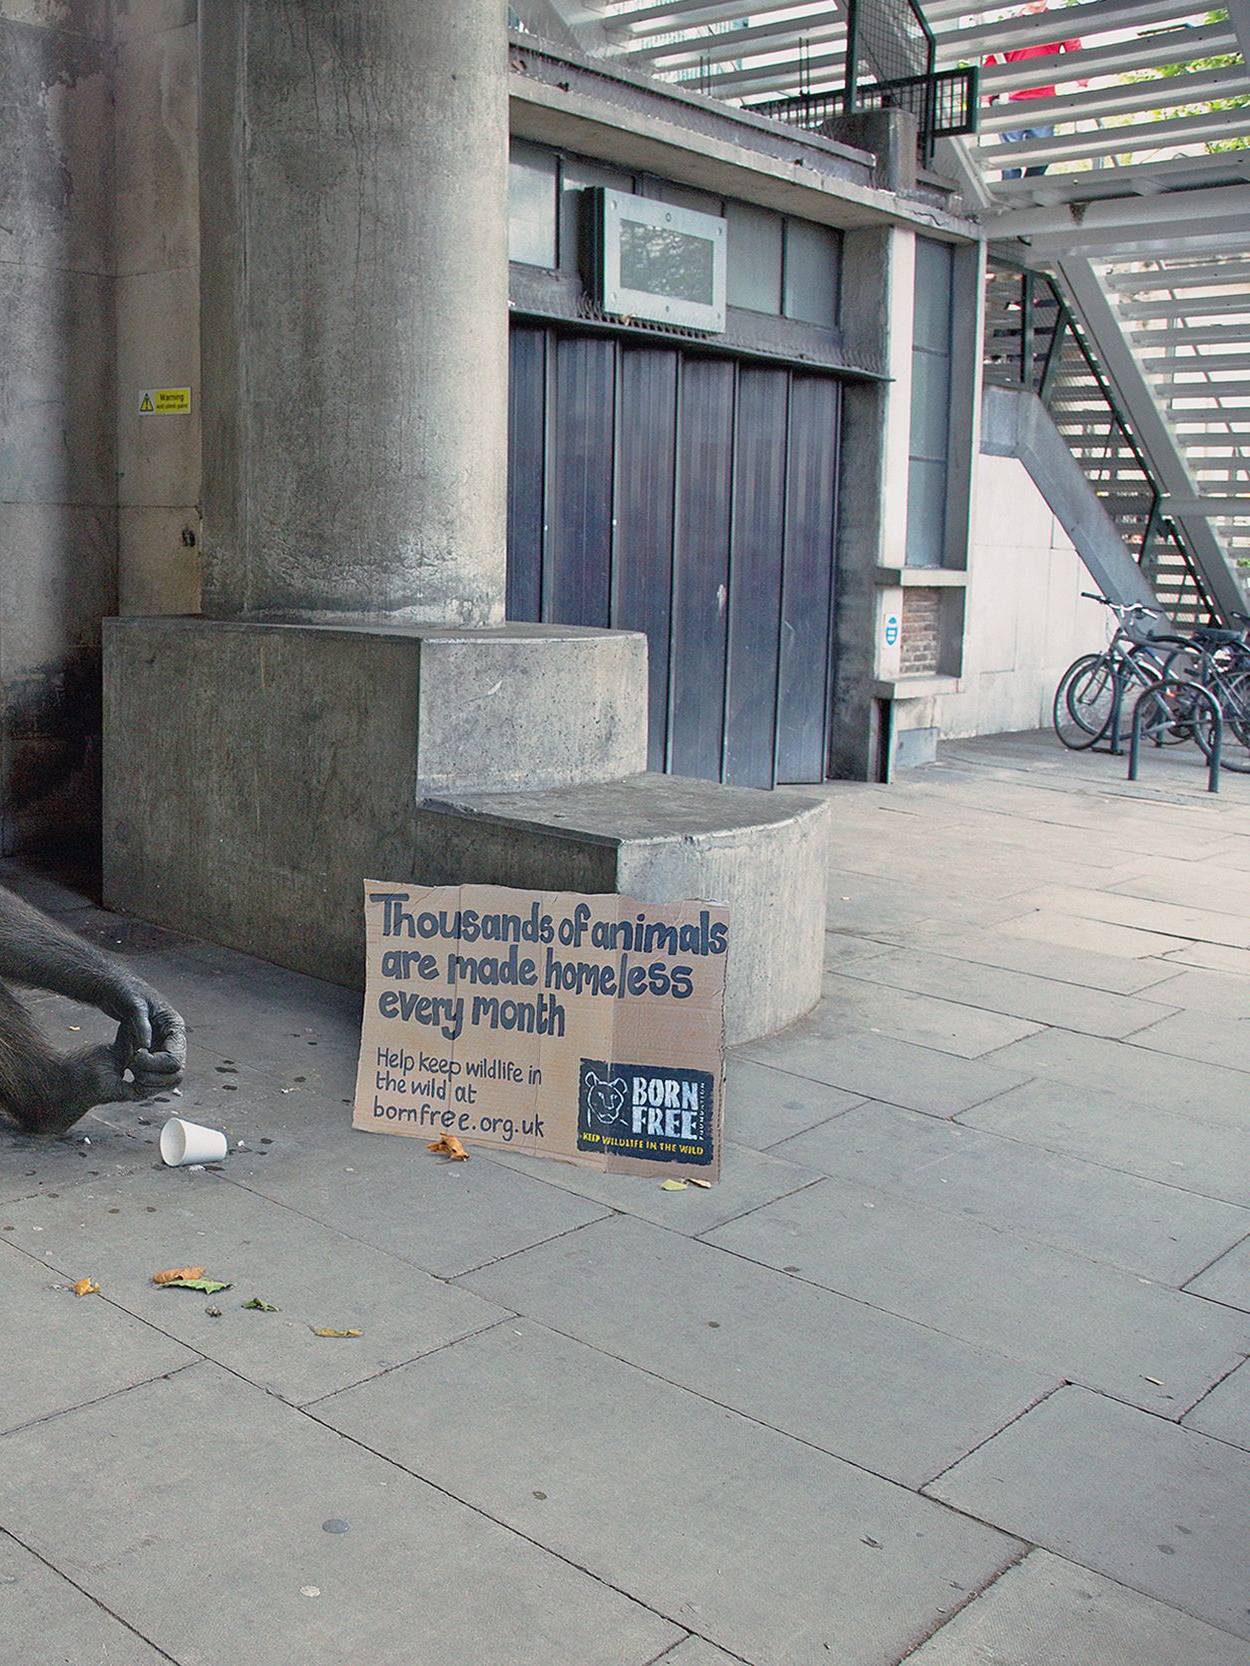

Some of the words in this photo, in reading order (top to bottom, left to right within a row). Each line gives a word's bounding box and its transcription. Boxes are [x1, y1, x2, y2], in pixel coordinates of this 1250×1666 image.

[160, 393, 184, 402] Warning
[370, 893, 555, 944] Thousands
[558, 903, 591, 947] of
[591, 910, 728, 956] animals
[381, 949, 440, 980] are
[447, 945, 538, 985] made
[545, 947, 693, 998] homeless
[378, 990, 463, 1040] every
[471, 993, 565, 1037] month
[377, 1047, 415, 1076] Help
[419, 1051, 462, 1082] keep
[466, 1058, 524, 1083] wildlife
[528, 1065, 542, 1085] in
[375, 1070, 407, 1093] the
[411, 1078, 447, 1100] wild
[455, 1084, 477, 1104] at
[632, 1077, 699, 1110] BORN
[373, 1095, 544, 1142] bornfree.org.uk
[632, 1106, 698, 1140] FREE
[582, 1132, 601, 1142] KEEP
[602, 1135, 644, 1149] WILDLIFE
[646, 1140, 658, 1151] IN
[660, 1142, 677, 1152] THE
[679, 1144, 704, 1155] WILD
